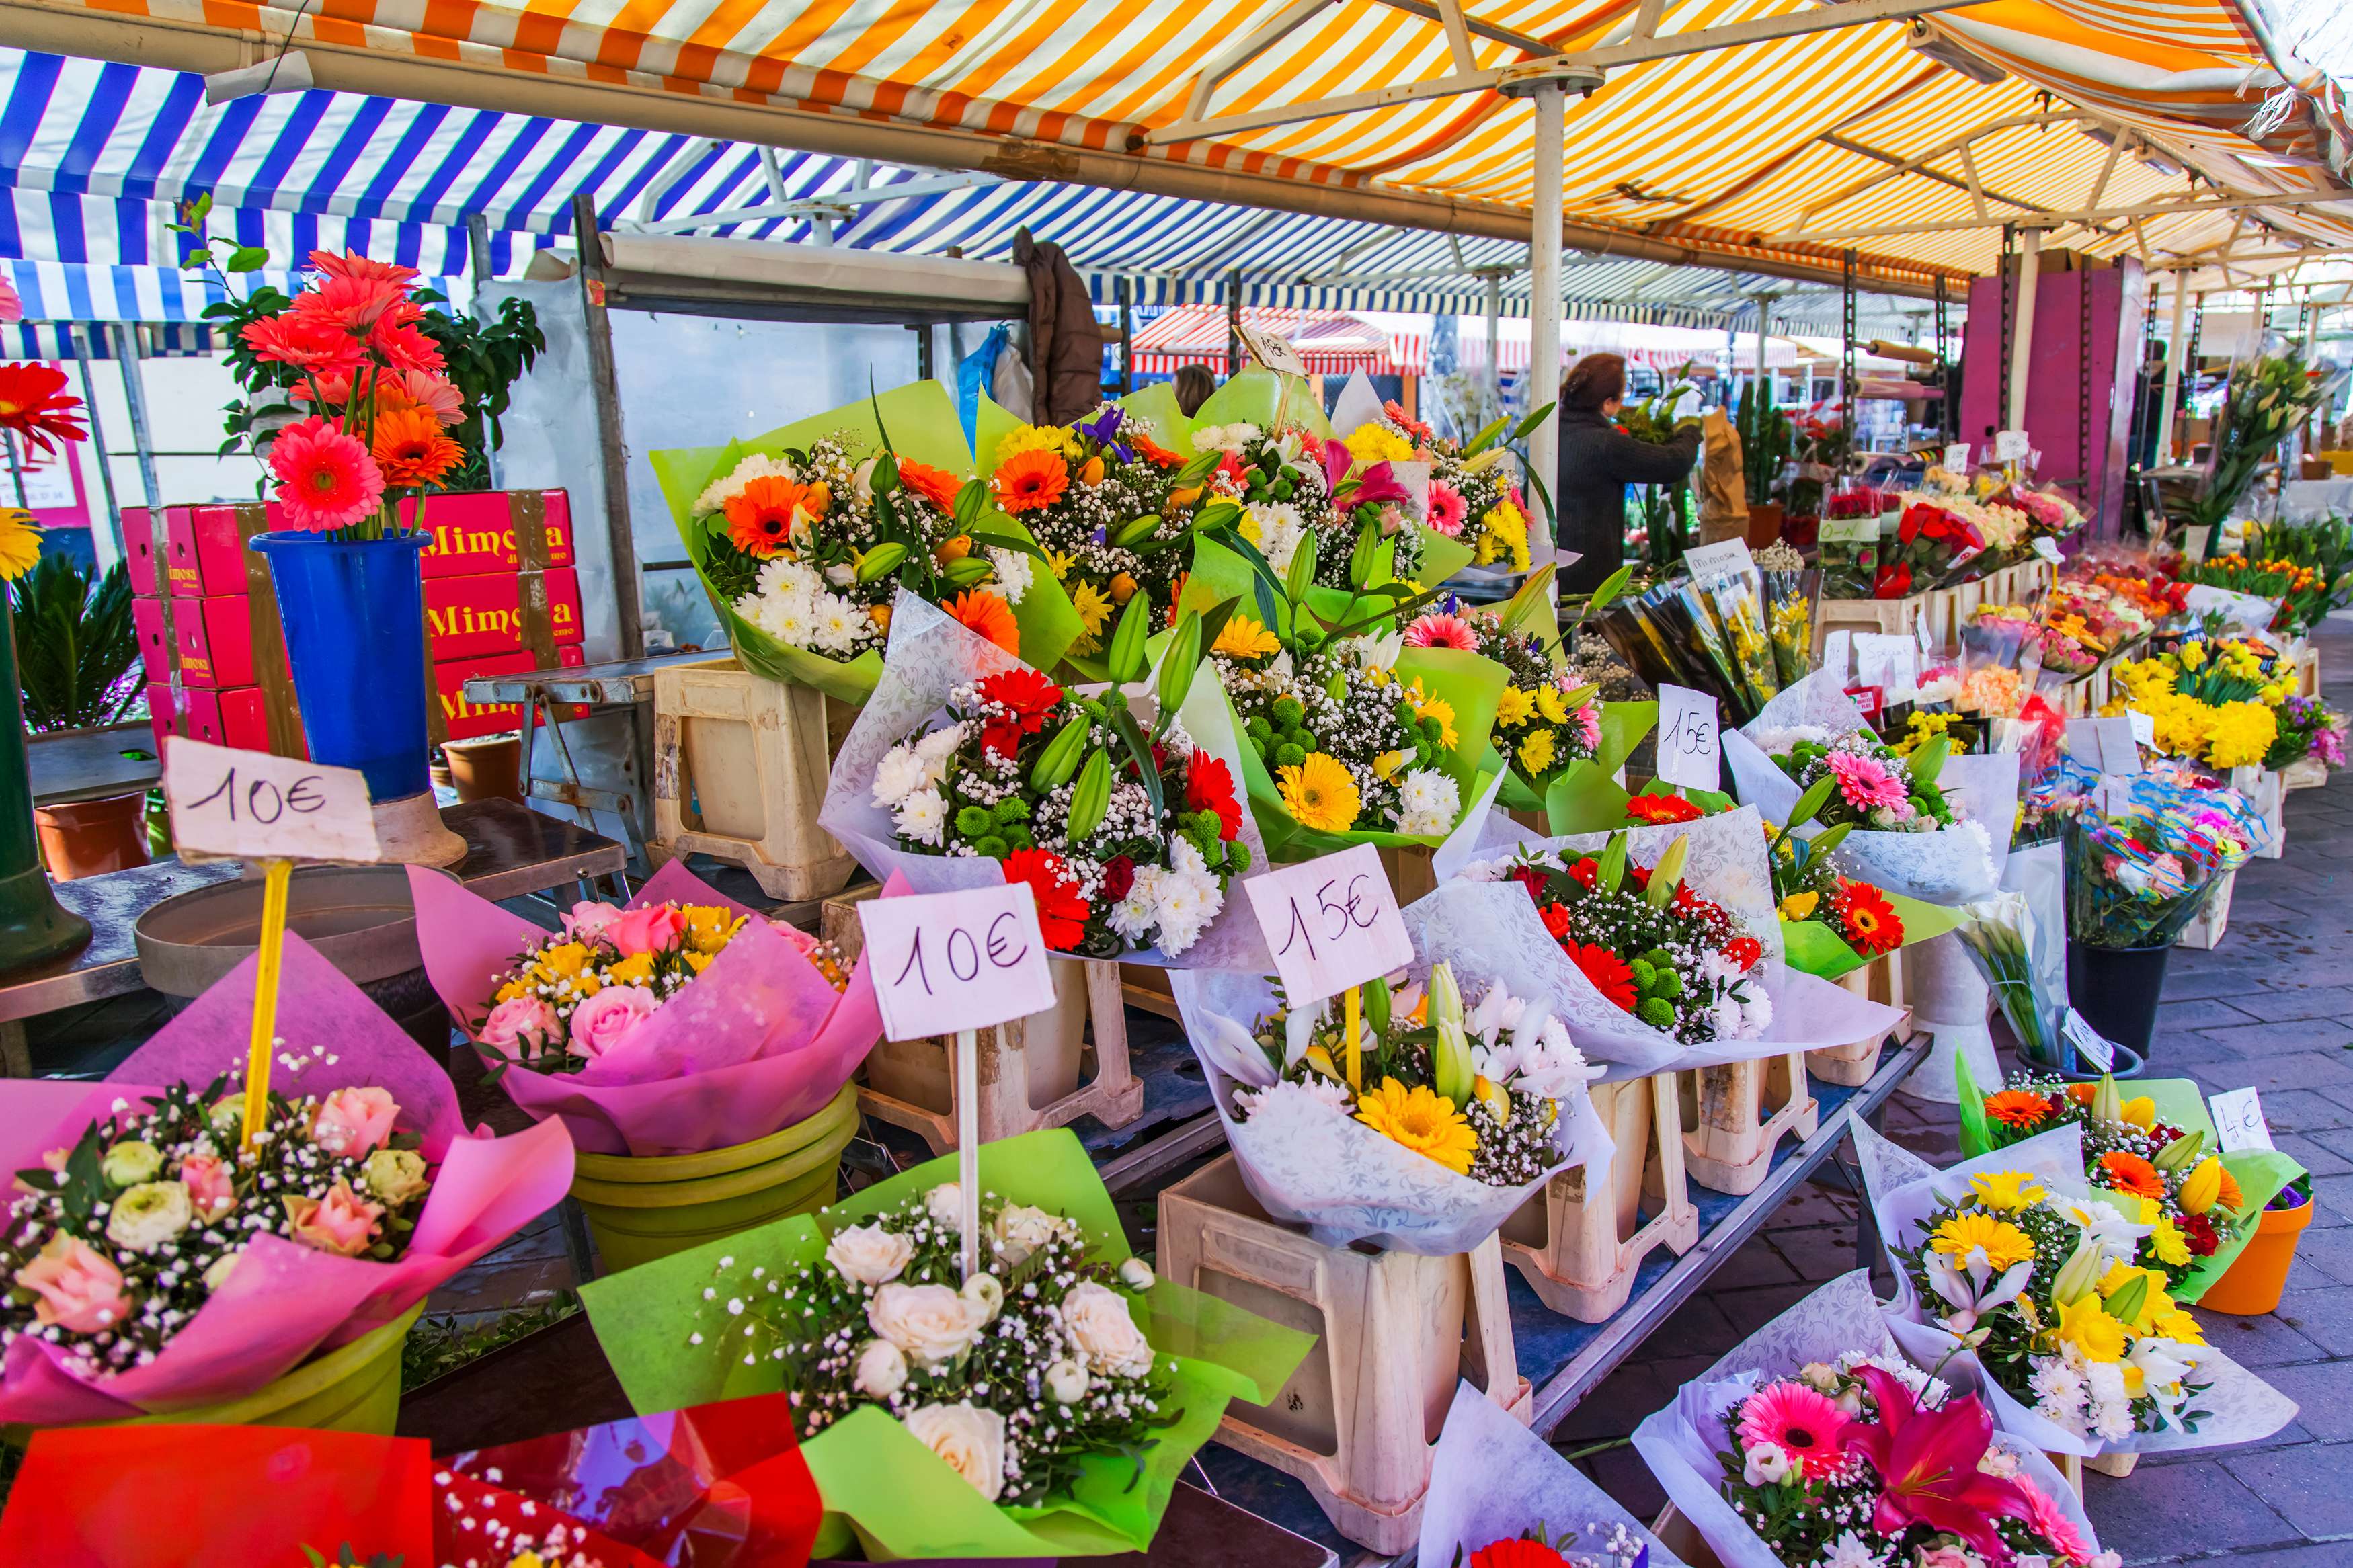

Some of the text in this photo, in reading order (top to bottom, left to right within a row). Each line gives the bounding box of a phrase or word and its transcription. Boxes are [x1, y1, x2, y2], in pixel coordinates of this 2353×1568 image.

[420, 526, 565, 556] Mimoa
[169, 565, 197, 581] imosa
[428, 603, 573, 637] Mimoa
[181, 653, 208, 670] imosa
[1664, 708, 1711, 755] 15€
[186, 767, 326, 824] 10€
[1279, 874, 1379, 960] 15€
[894, 912, 1027, 995] 10€
